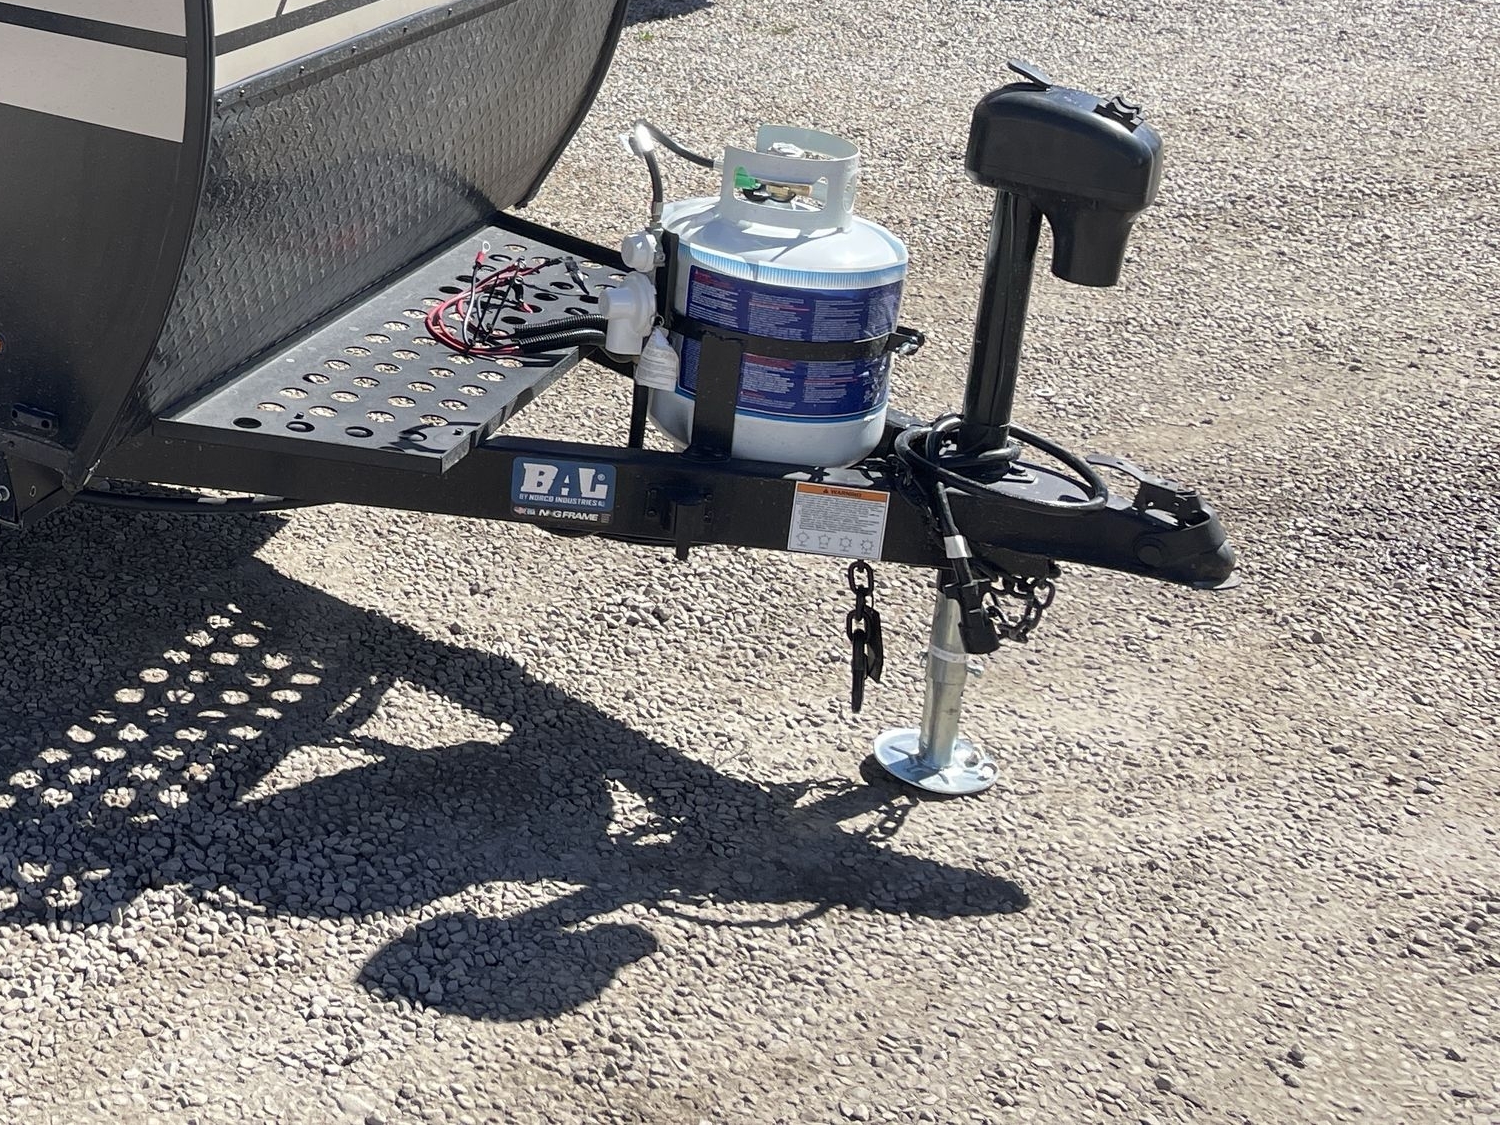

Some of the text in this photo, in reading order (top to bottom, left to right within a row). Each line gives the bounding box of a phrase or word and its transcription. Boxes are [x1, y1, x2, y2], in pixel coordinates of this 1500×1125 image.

[529, 494, 554, 503] NORCO
[555, 496, 599, 507] INDUSTRIES
[562, 511, 599, 522] FRAME
